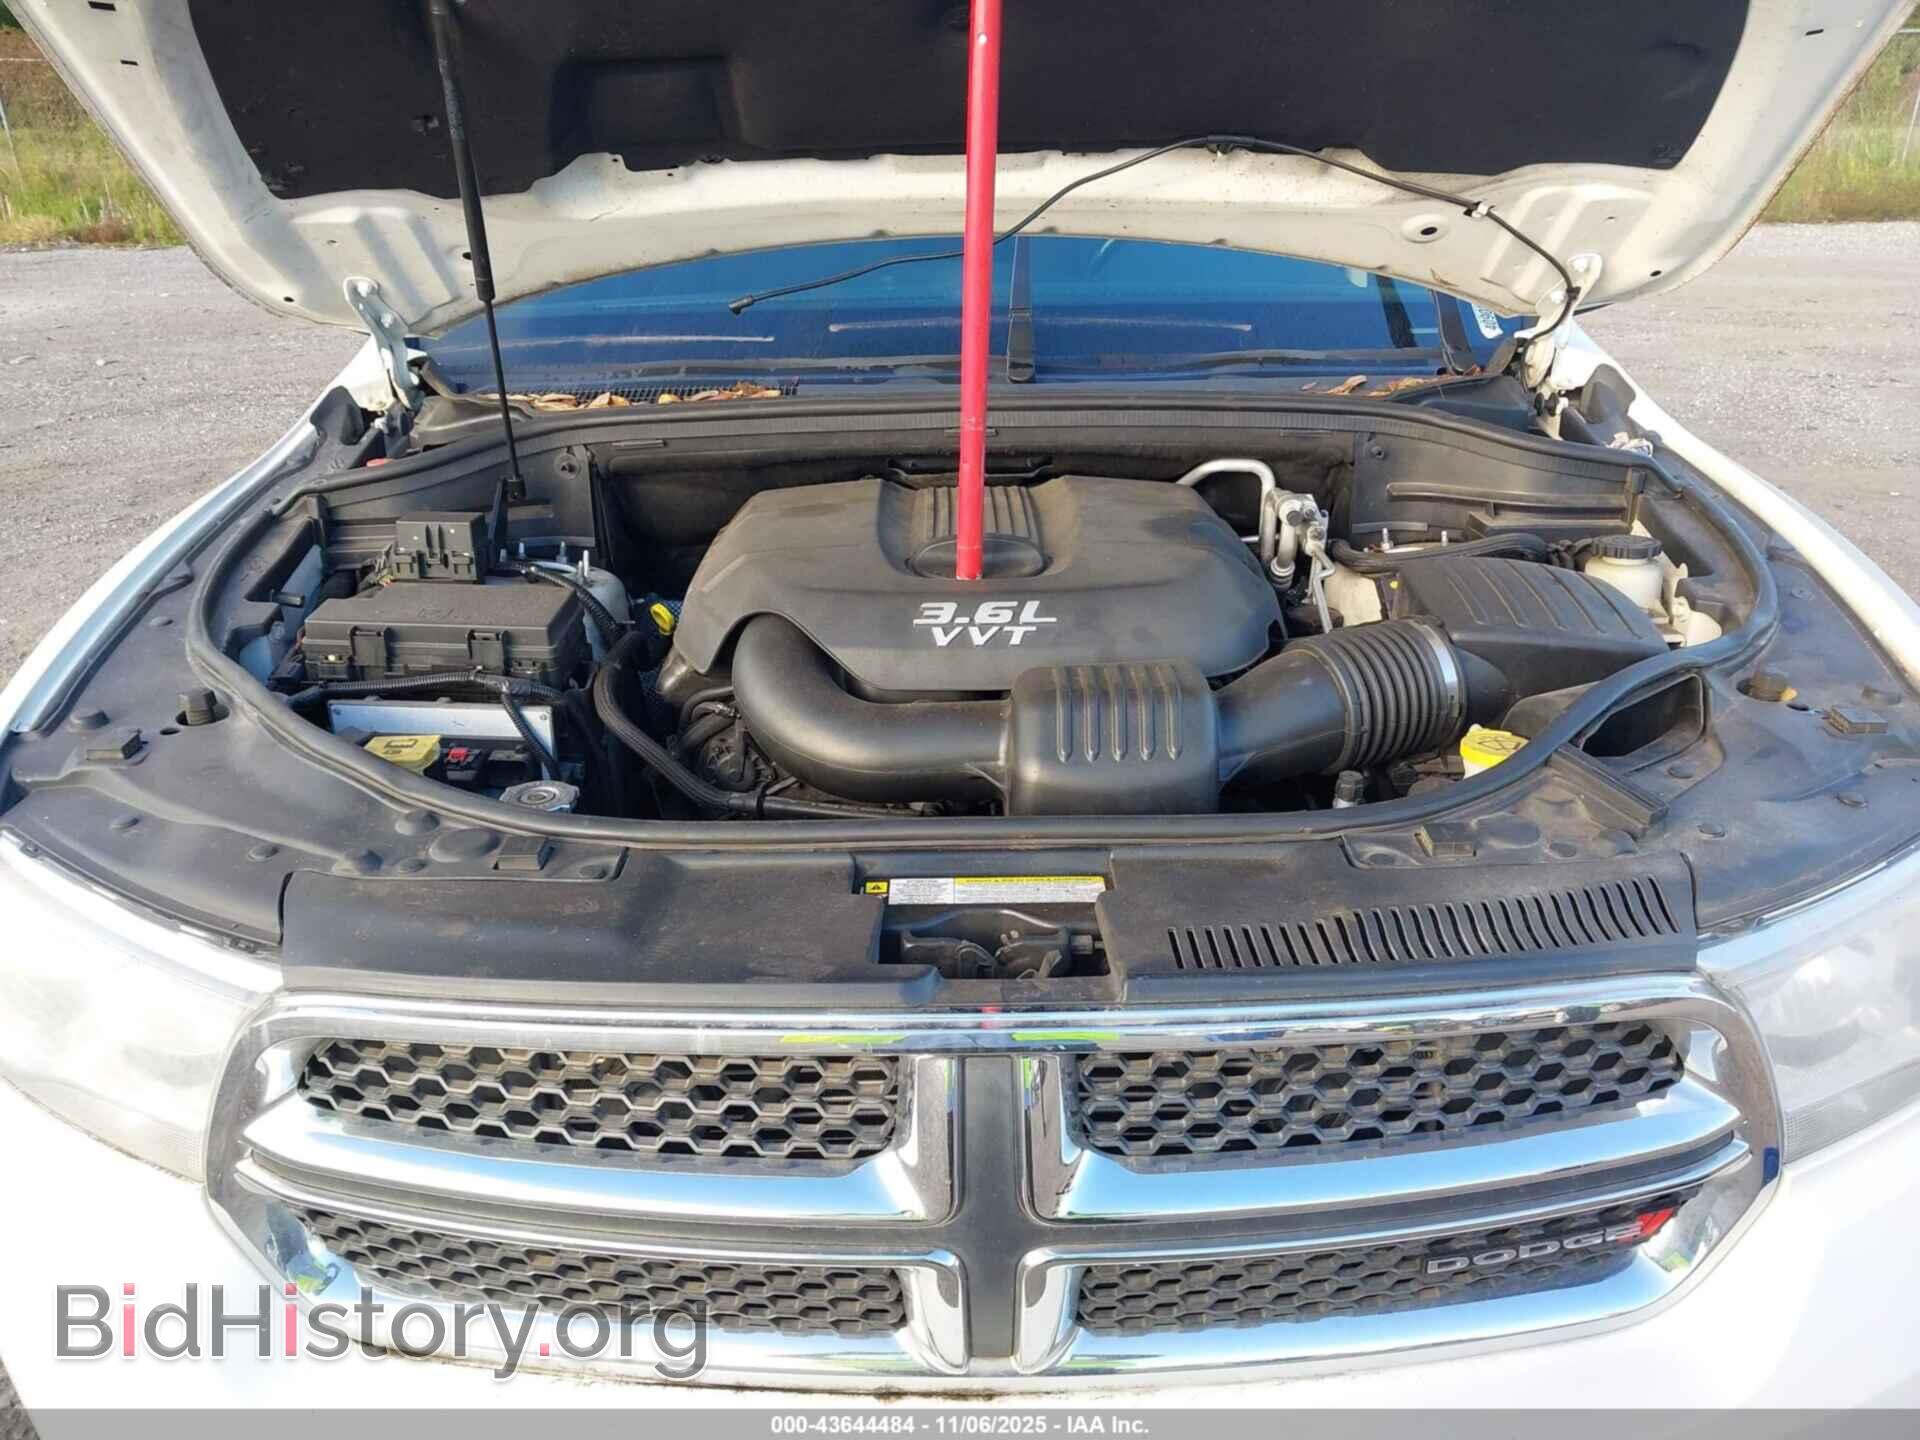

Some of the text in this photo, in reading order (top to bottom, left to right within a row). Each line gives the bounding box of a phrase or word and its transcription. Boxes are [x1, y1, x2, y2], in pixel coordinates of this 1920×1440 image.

[913, 600, 1057, 625] 3.6L
[931, 626, 1037, 647] VVT
[1427, 1222, 1642, 1275] DODGE
